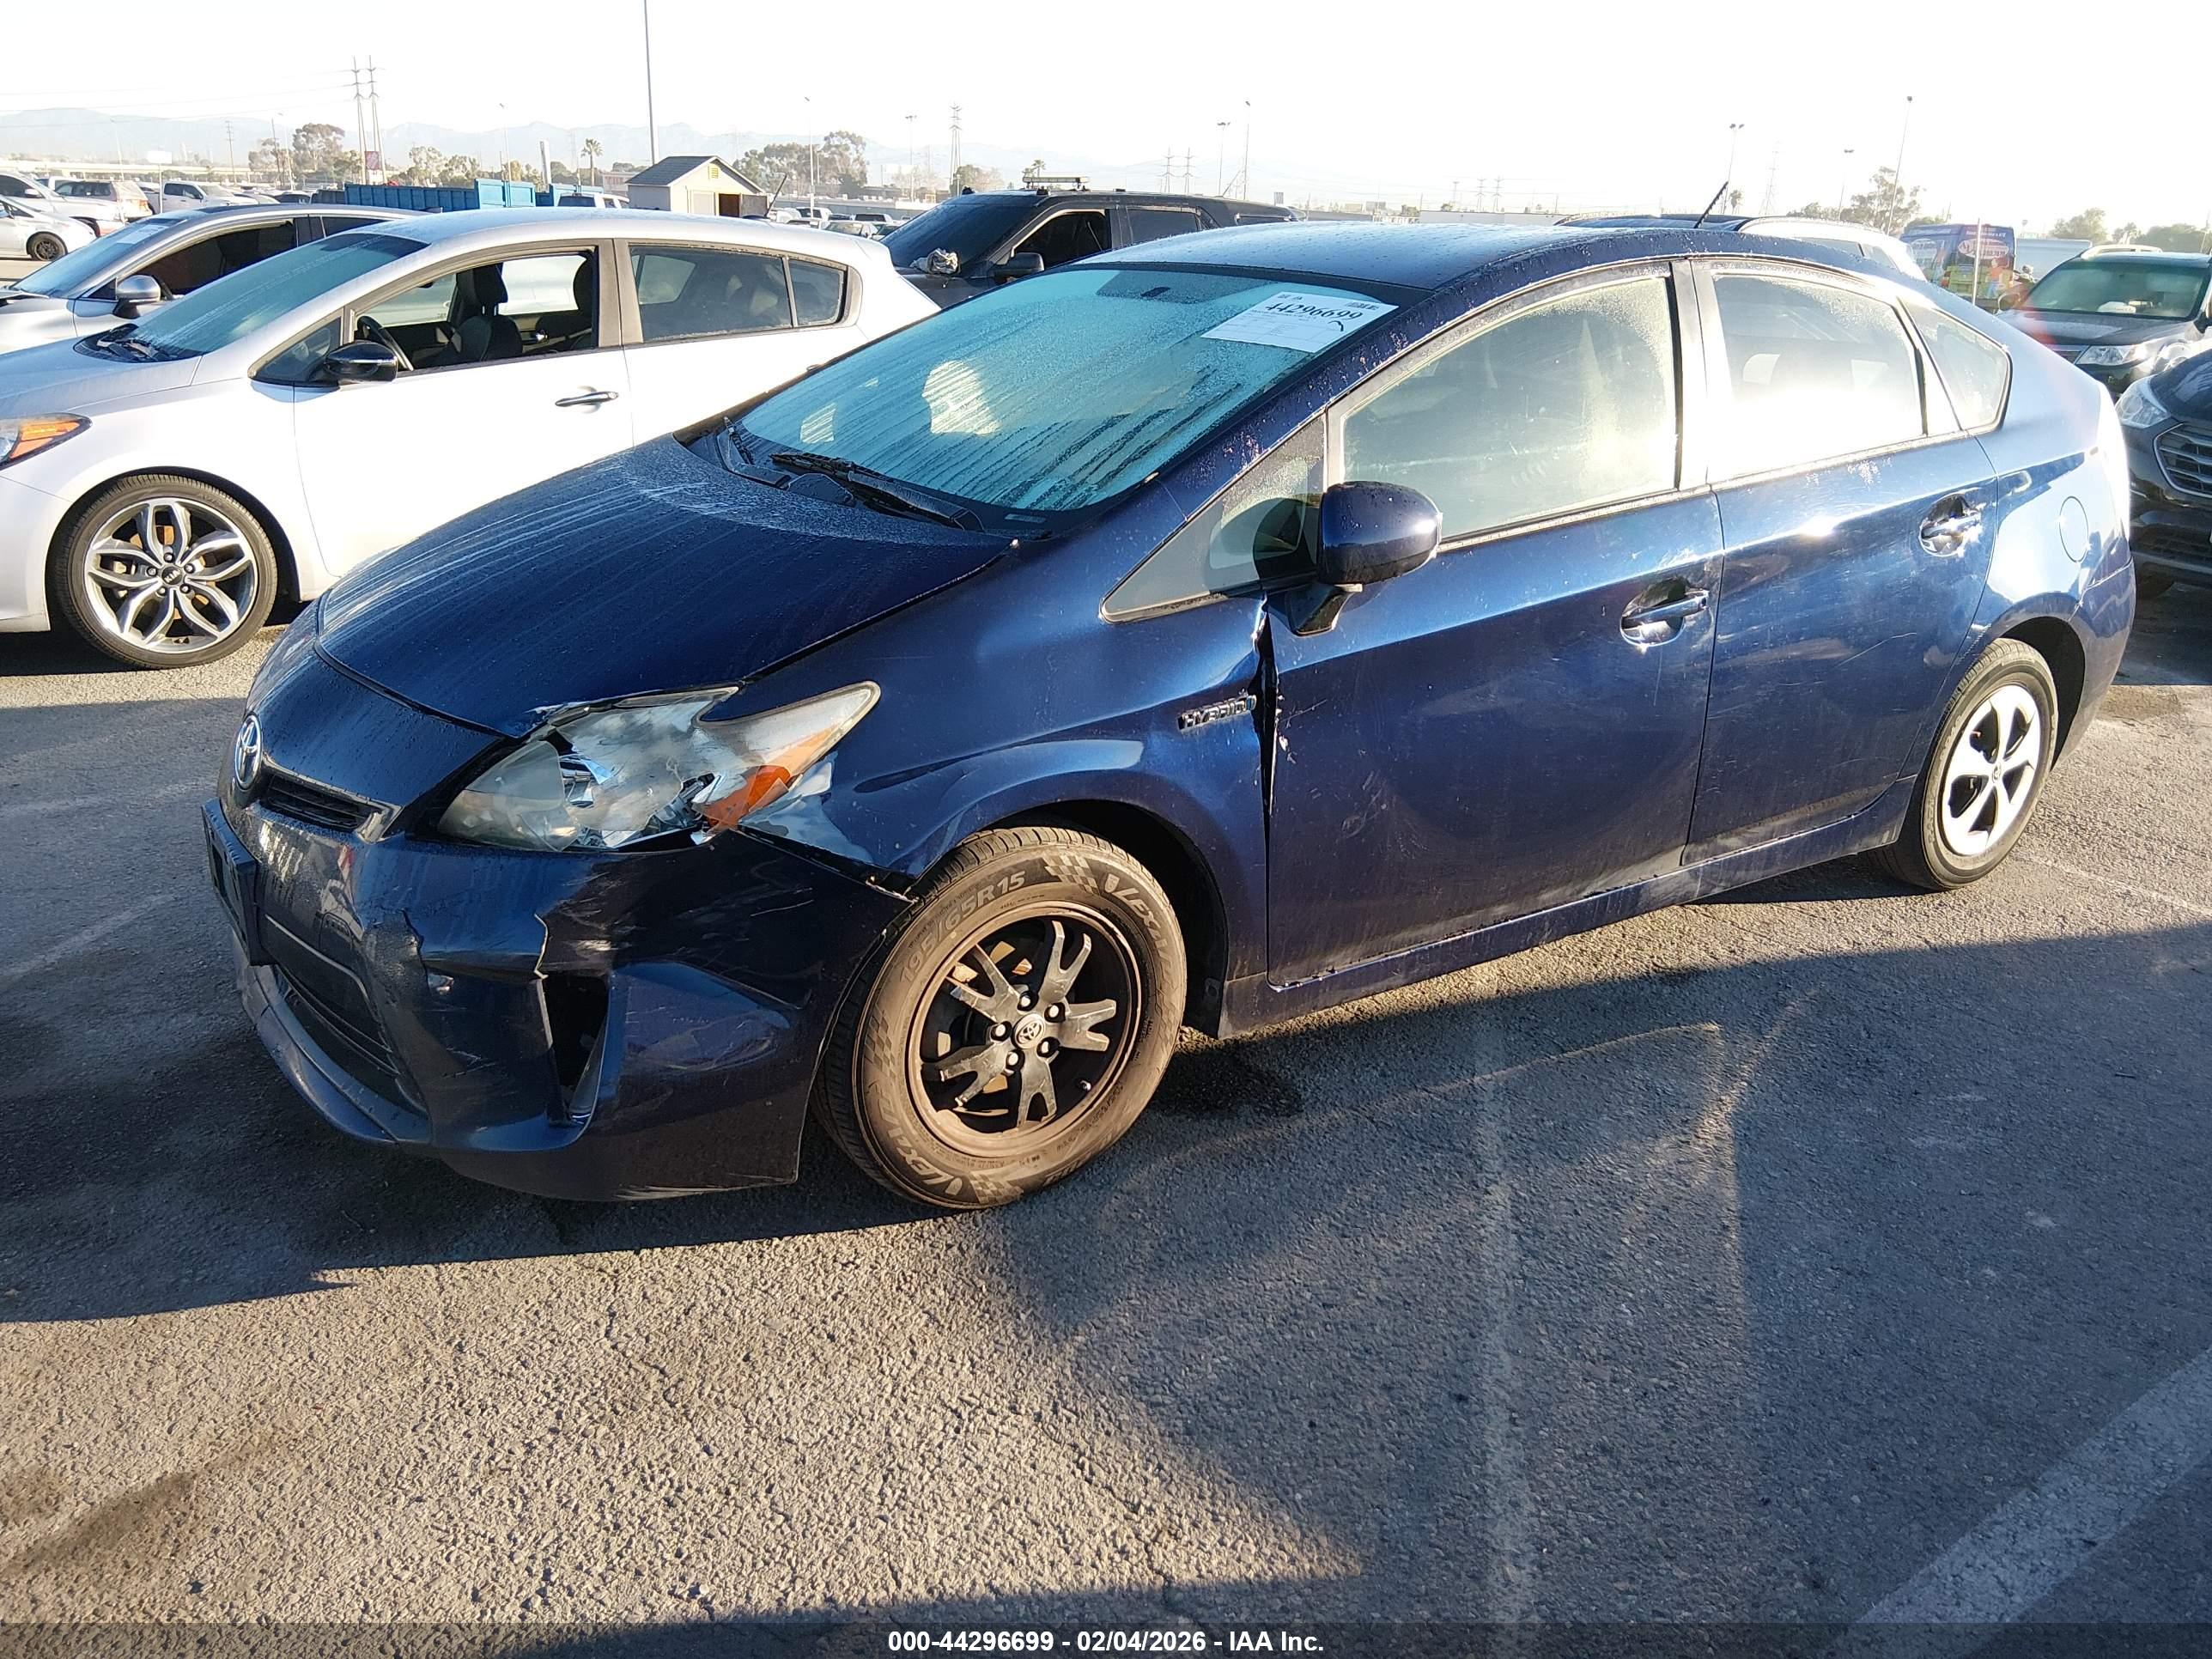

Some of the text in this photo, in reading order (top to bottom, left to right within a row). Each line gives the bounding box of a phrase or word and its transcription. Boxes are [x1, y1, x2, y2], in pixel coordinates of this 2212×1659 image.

[1265, 302, 1363, 320] 44296699
[163, 568, 181, 583] KIA
[898, 869, 1026, 985] 195/65R15
